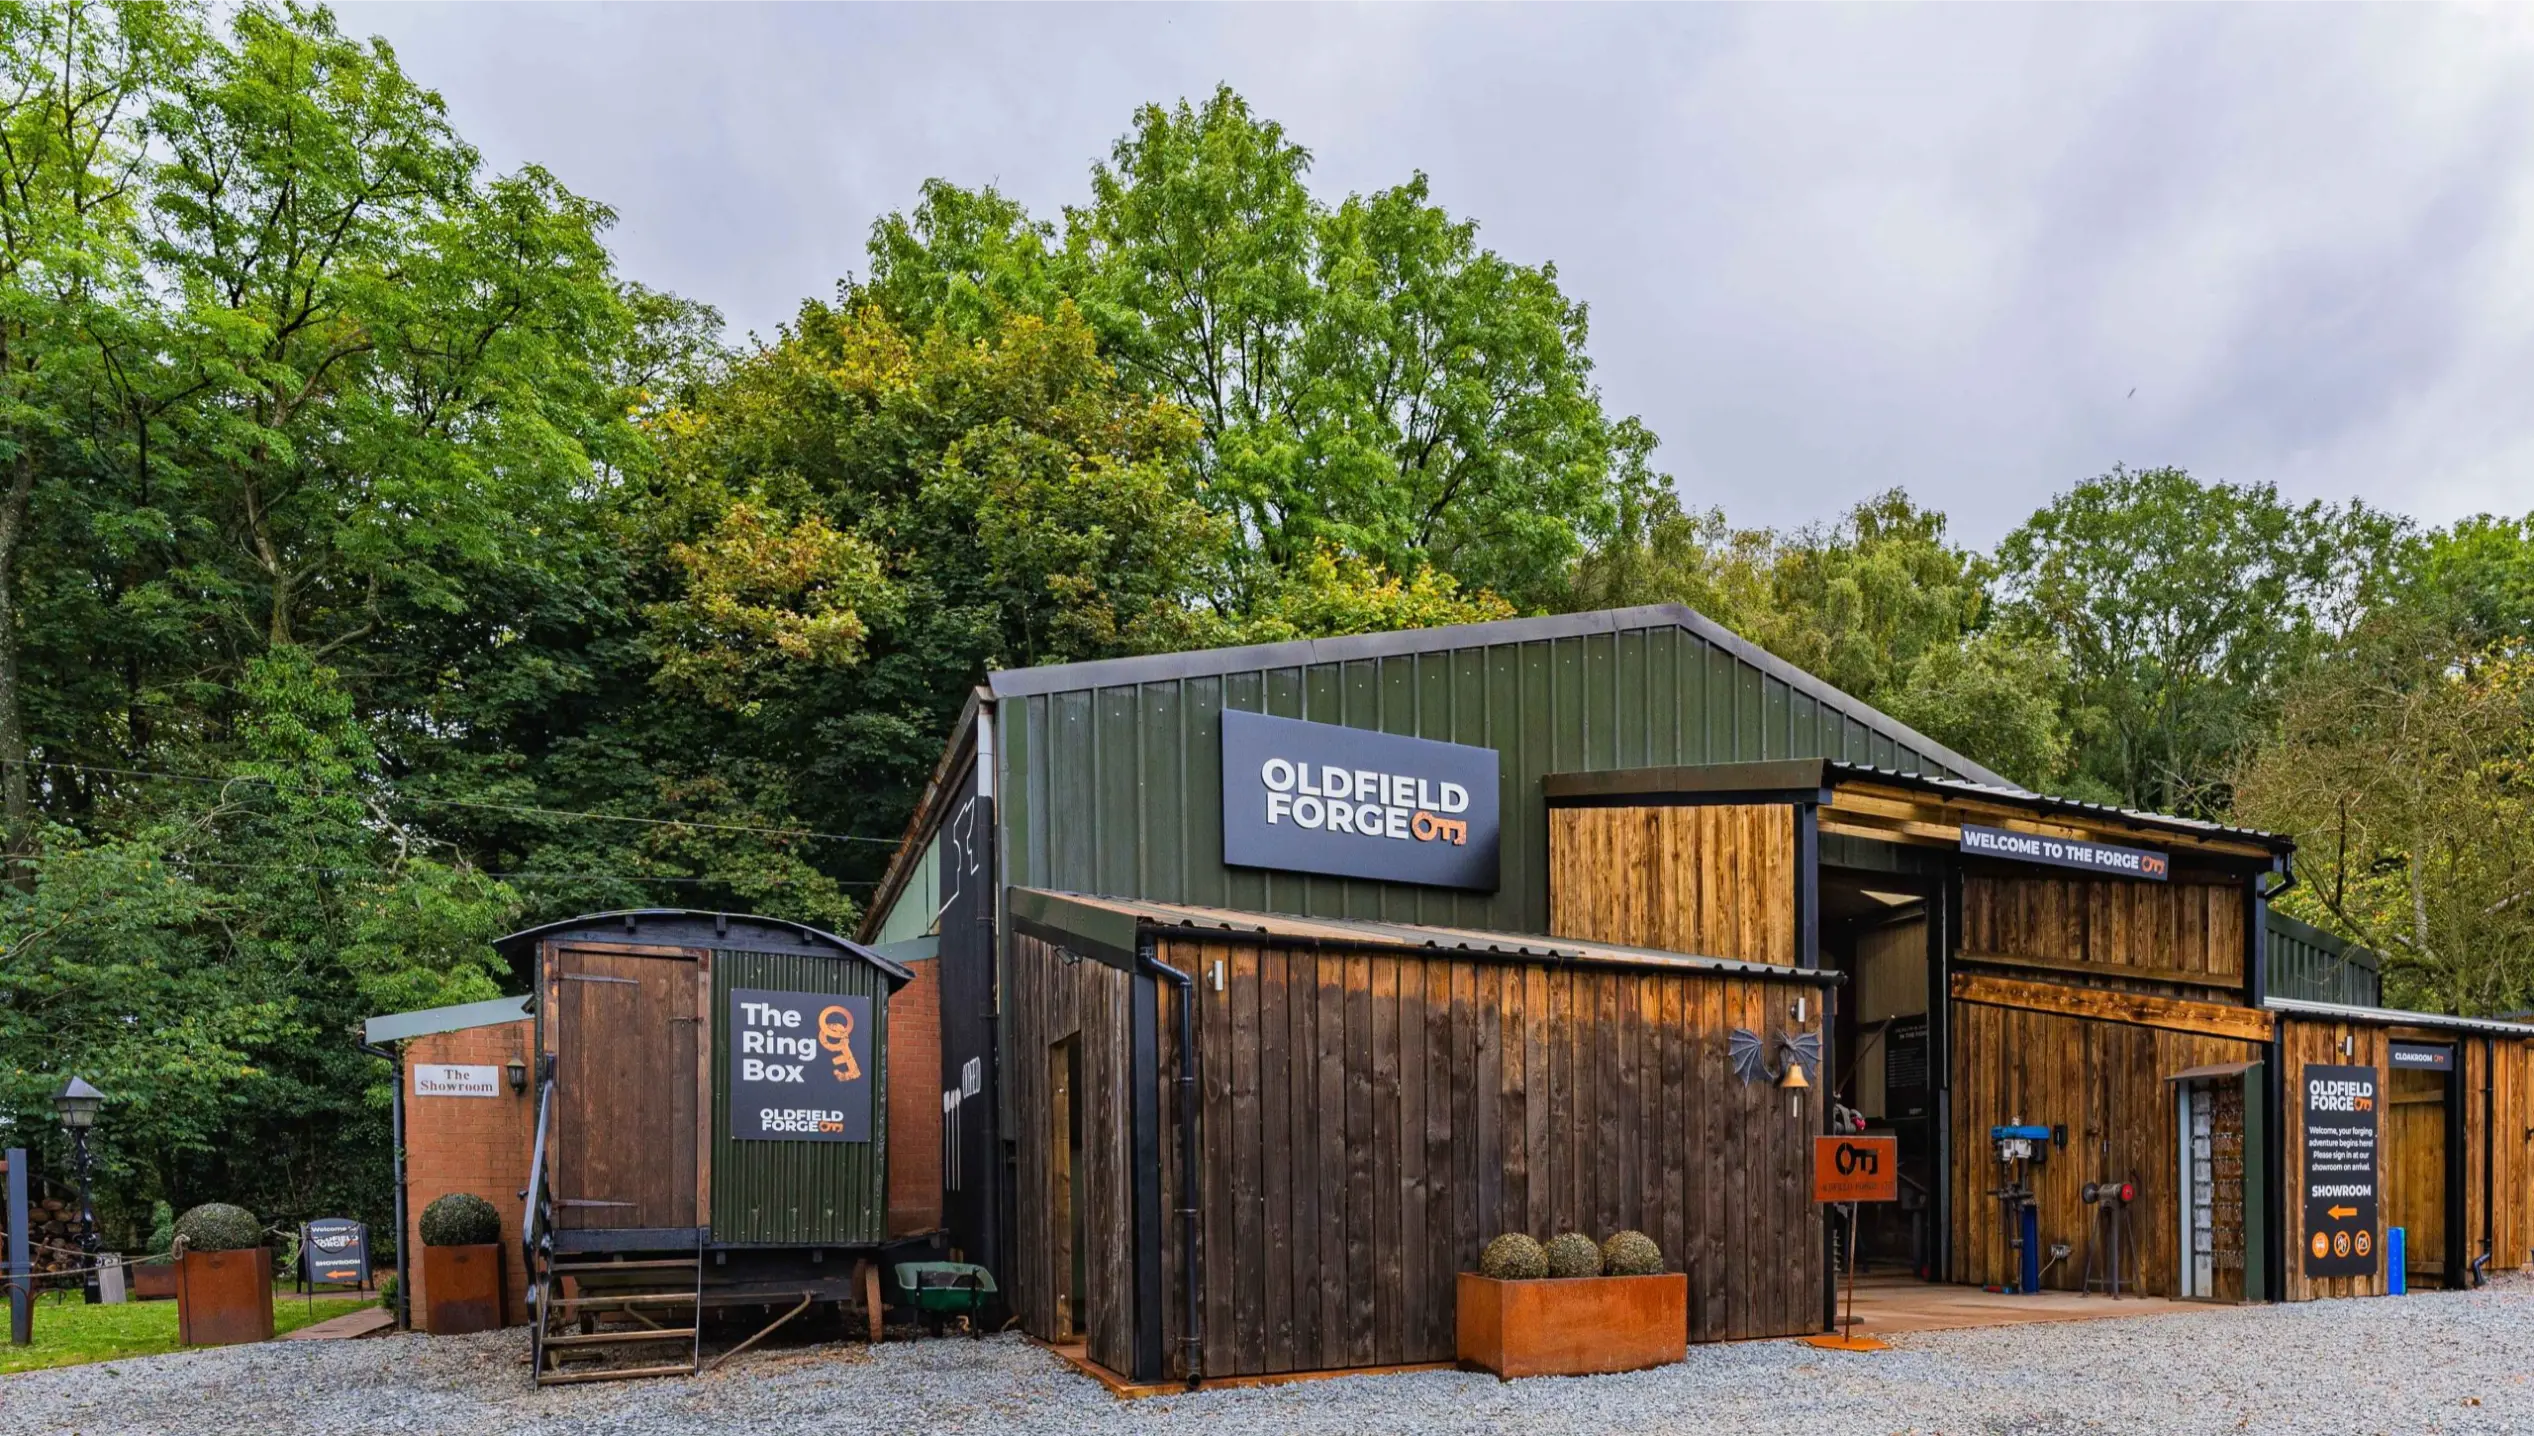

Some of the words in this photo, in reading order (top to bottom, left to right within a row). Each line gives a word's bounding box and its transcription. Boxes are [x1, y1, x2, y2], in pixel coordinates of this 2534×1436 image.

[1261, 758, 1469, 813] OLDFIELD
[1266, 792, 1409, 839] FORGE
[1964, 830, 2040, 855] WELCOME
[2042, 842, 2062, 858] TO
[2065, 845, 2092, 862] THE
[2095, 850, 2139, 870] FORGE
[740, 1002, 801, 1028] The
[742, 1029, 817, 1062] Ring
[2394, 1052, 2433, 1062] CLOAKROOM
[443, 1069, 470, 1080] The
[742, 1058, 805, 1083] Box
[420, 1080, 493, 1092] Showroom
[2309, 1079, 2373, 1097] OLDFIELD
[2311, 1095, 2354, 1112] FORGE
[760, 1108, 844, 1122] OLDFIELD
[762, 1119, 819, 1133] FORGE
[2308, 1126, 2338, 1136] Welcome,
[2339, 1127, 2352, 1136] your
[2352, 1126, 2373, 1137] forging
[2308, 1138, 2338, 1147] adventure
[2339, 1138, 2359, 1148] begins
[2313, 1150, 2332, 1159] Please
[2333, 1150, 2345, 1160] sign
[2346, 1150, 2352, 1159] in
[2352, 1151, 2359, 1159] at
[2312, 1163, 2343, 1171] showroom
[2312, 1185, 2372, 1197] SHOWROOM
[315, 1259, 361, 1267] SHOWROOM
